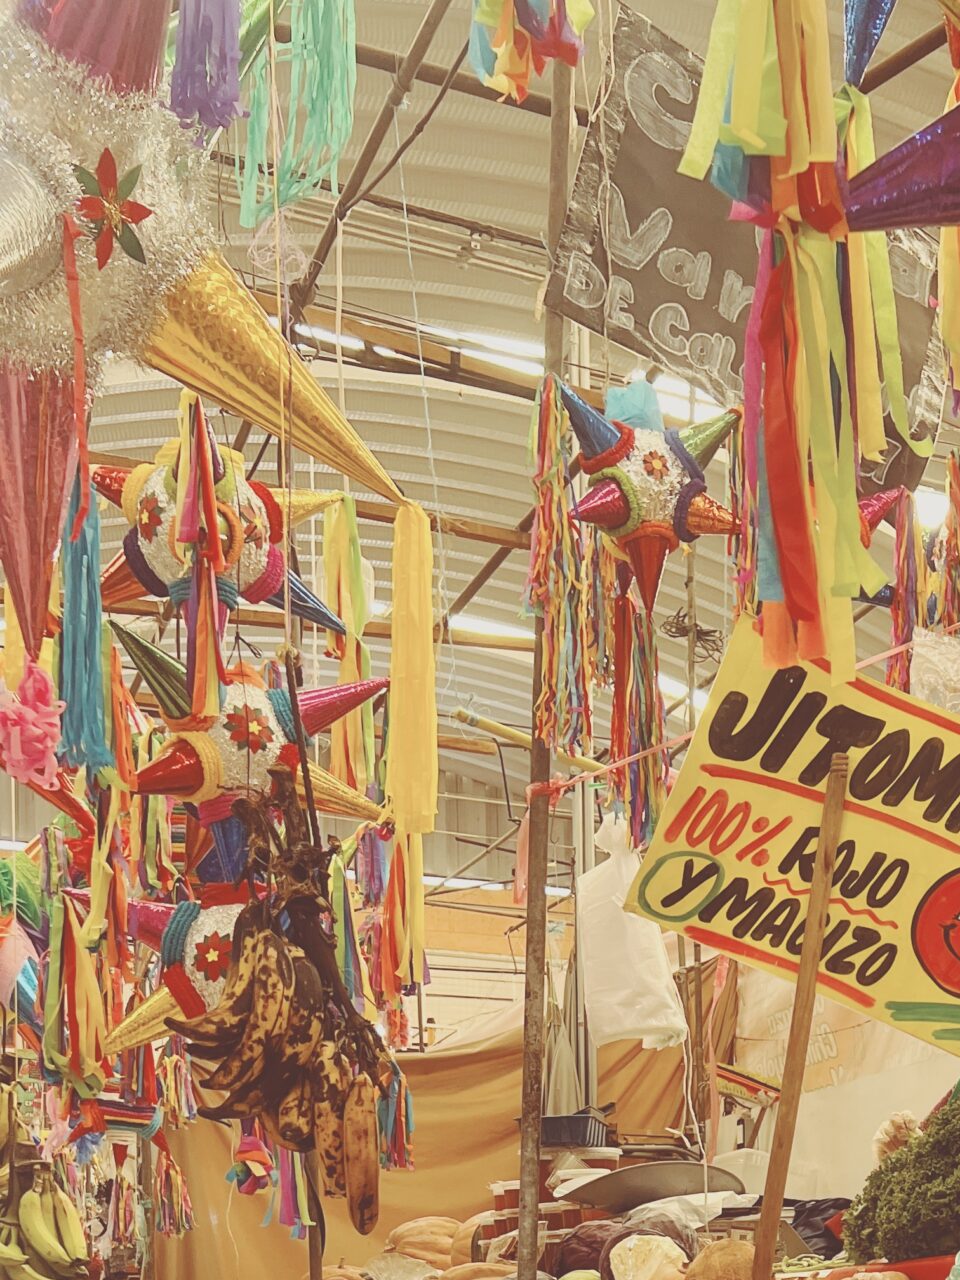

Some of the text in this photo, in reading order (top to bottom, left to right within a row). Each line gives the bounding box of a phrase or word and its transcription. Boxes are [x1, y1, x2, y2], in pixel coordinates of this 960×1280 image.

[663, 786, 910, 908] 100% ROJO
[661, 858, 898, 986] Y MACIZO
